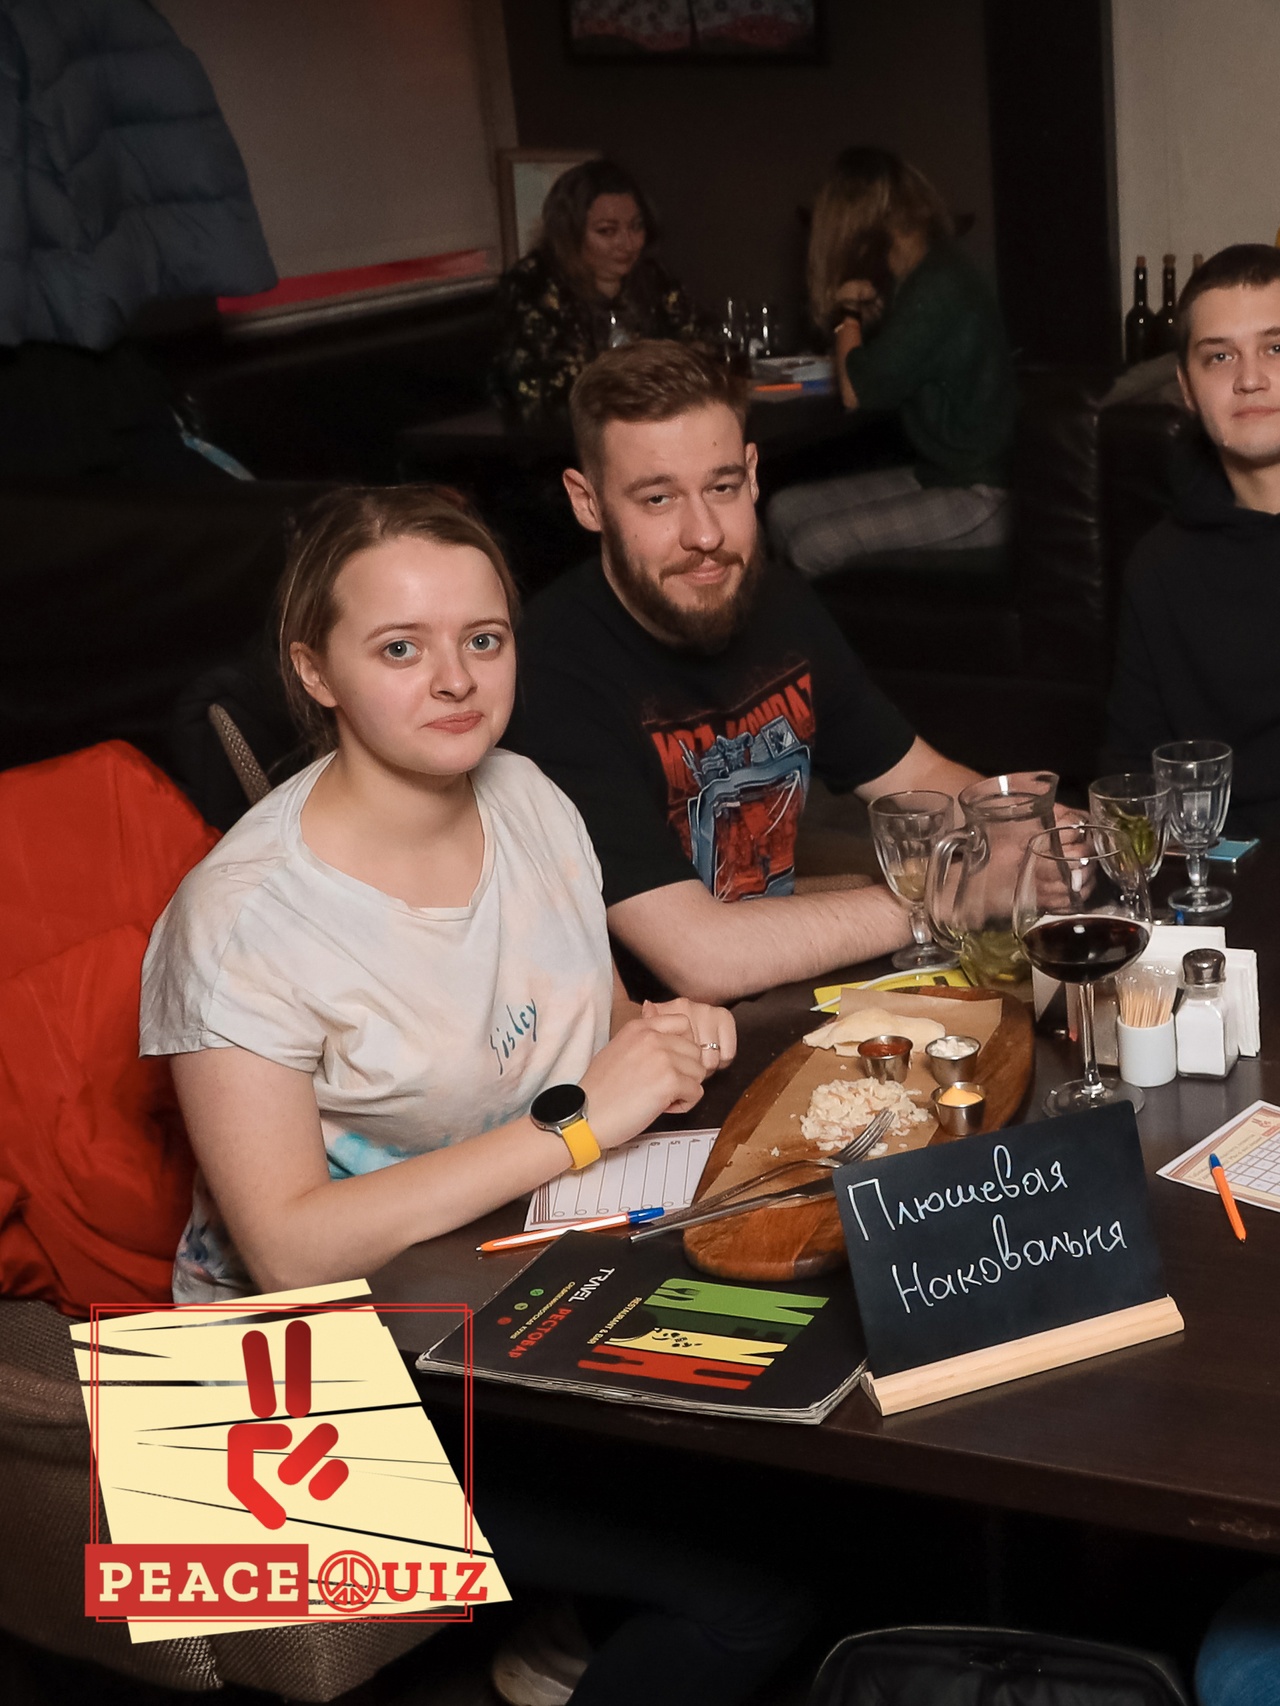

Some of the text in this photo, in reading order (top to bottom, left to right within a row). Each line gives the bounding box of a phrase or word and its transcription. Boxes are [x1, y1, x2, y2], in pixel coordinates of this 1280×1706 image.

[847, 1145, 1068, 1241] Плюшевая
[892, 1214, 1128, 1314] Наковальня
[508, 1267, 616, 1358] TRAVEL РЕСТОБАР
[587, 1333, 604, 1345] BAR
[605, 1296, 643, 1330] RESTAURANT
